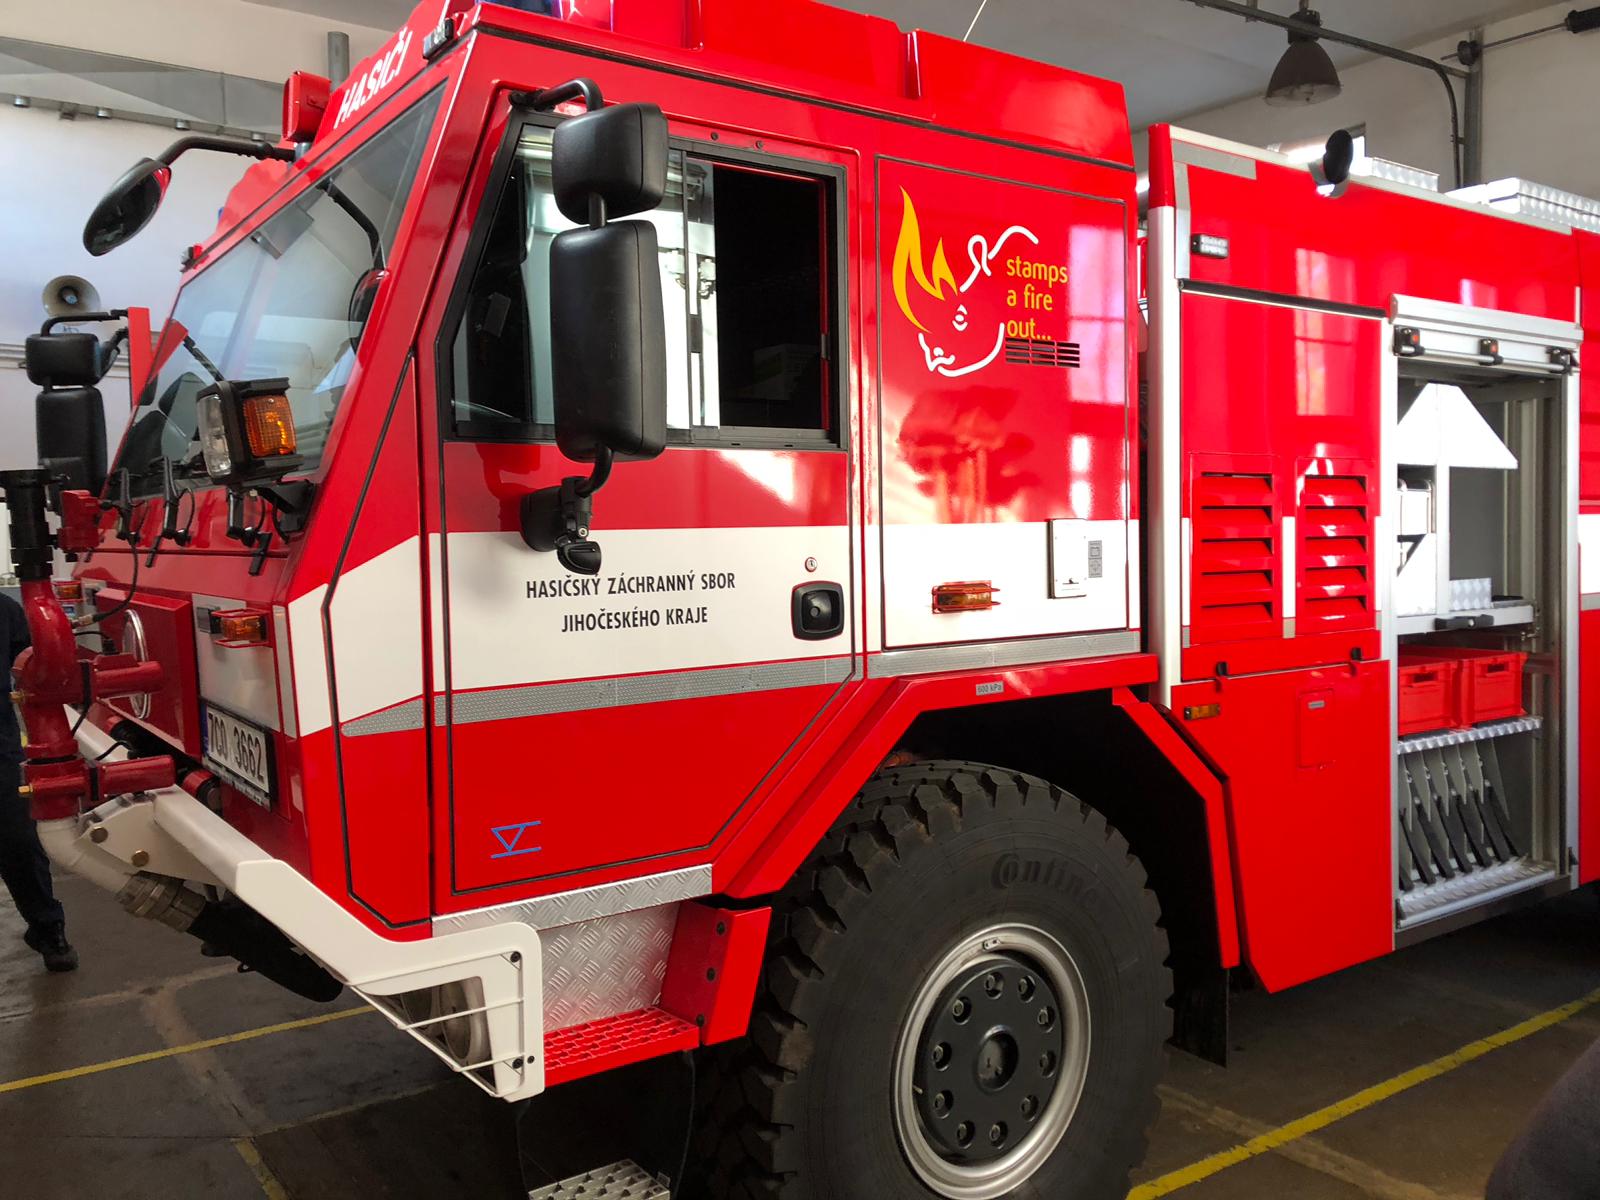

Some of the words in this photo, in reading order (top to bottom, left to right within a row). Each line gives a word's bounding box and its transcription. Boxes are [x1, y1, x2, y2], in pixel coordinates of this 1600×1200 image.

[333, 26, 413, 129] HASIČI
[1006, 255, 1069, 289] stamps
[1006, 289, 1017, 307] a
[1023, 283, 1053, 311] fire
[1006, 317, 1052, 340] out...
[526, 573, 601, 599] HASIČSKÝ
[607, 569, 696, 595] ZÁCHRANNÝ
[701, 572, 736, 590] SBOR
[561, 606, 661, 633] JIHOČESKÉHO
[665, 606, 708, 626] KRAJE
[234, 726, 264, 784] 3662
